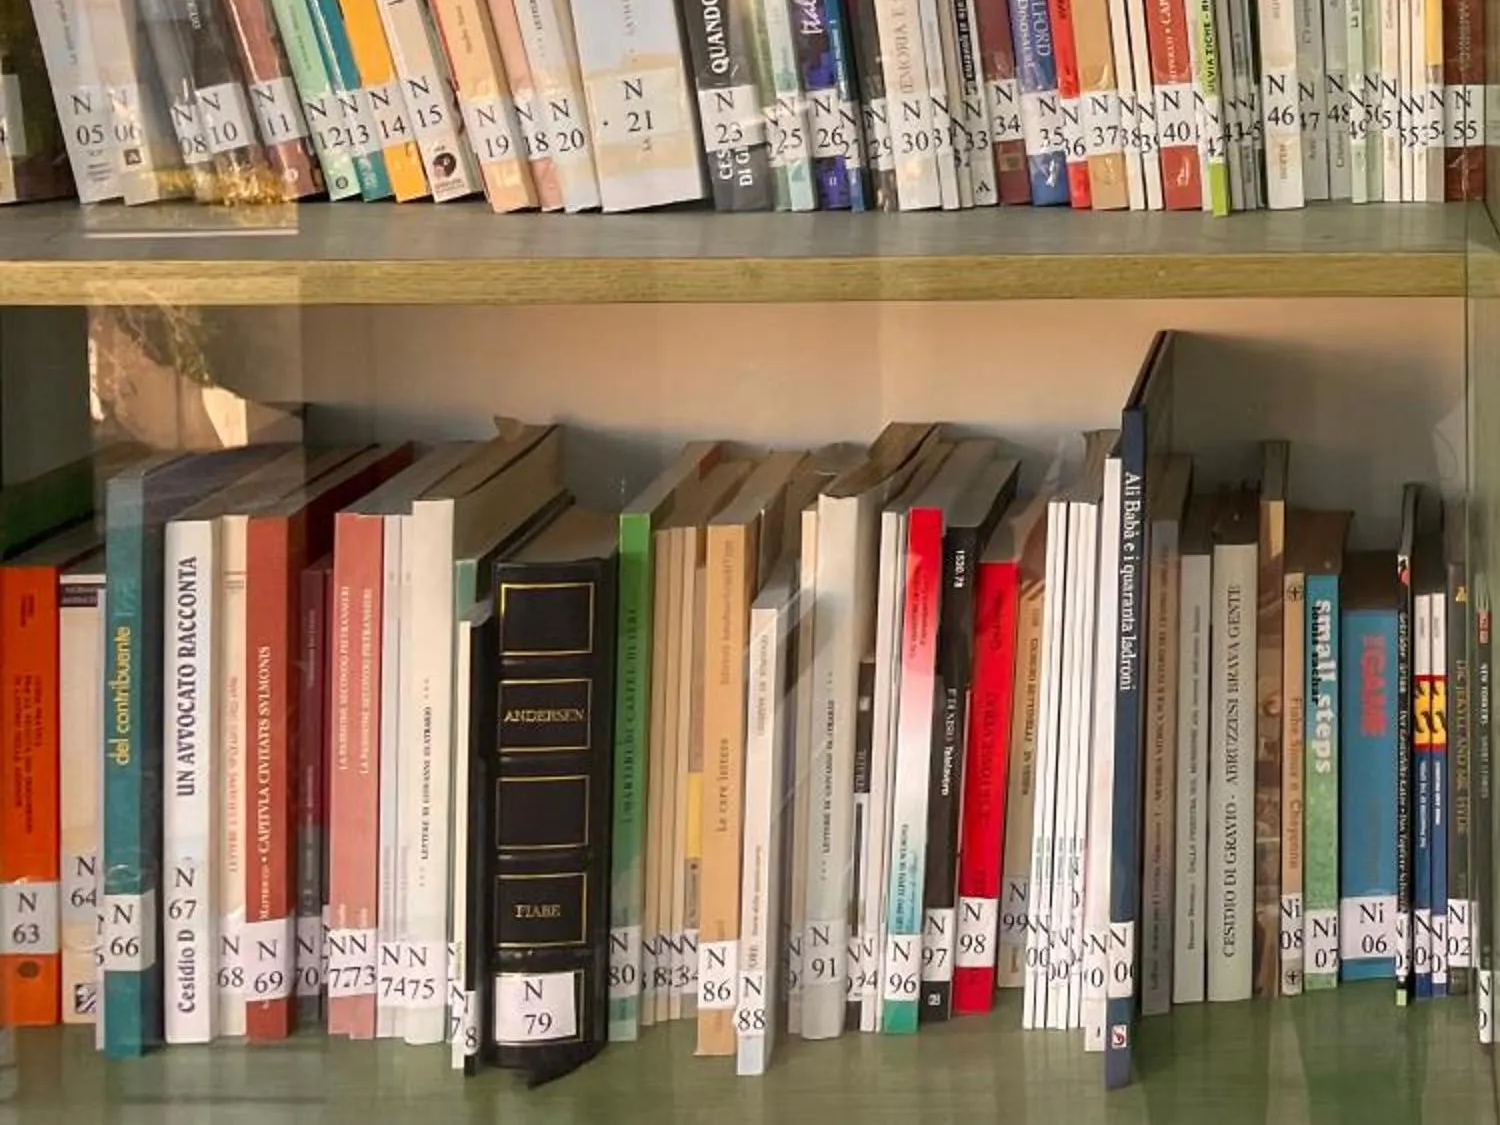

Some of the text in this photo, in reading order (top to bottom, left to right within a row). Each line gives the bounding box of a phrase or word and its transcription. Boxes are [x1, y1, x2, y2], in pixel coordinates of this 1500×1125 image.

[623, 78, 644, 100] N
[1267, 75, 1286, 95] N
[1161, 91, 1181, 111] N
[628, 110, 653, 132] 21
[1268, 106, 1294, 126] 46
[902, 133, 929, 153] 30
[1124, 472, 1141, 498] Ali
[1122, 500, 1140, 540] Babà
[1123, 542, 1135, 552] e
[1117, 564, 1134, 632] quaranta
[1118, 635, 1137, 691] ladroni
[177, 555, 198, 797] UN AVVOCATO RACCONTA
[1312, 599, 1337, 774] small steps
[112, 624, 132, 766] del contribuente
[503, 706, 585, 723] ANDERSEN
[255, 645, 272, 855] CAPITVLA CIVITATIS SVLMONIS
[1223, 583, 1242, 958] CESIDIO DI GRAVIO ABRUZZESI BRAVA GENTE
[175, 867, 194, 888] N
[19, 893, 37, 913] N
[168, 899, 197, 920] 67
[514, 903, 561, 918] FIABE
[963, 902, 983, 922] N
[1360, 903, 1384, 923] Ni
[114, 904, 133, 924] N
[13, 923, 40, 944] 63
[812, 926, 830, 946] N
[110, 937, 139, 957] 66
[221, 936, 240, 955] N
[259, 939, 278, 961] N
[892, 942, 911, 962] N
[959, 935, 986, 954] 98
[1362, 935, 1387, 954] 06
[217, 967, 244, 988] 68
[812, 958, 836, 978] 91
[178, 948, 196, 1013] Cesidio
[253, 972, 283, 993] 69
[525, 980, 543, 1001] N
[890, 974, 917, 994] 96
[704, 981, 731, 1002] 86
[525, 1013, 552, 1034] 79
[738, 1010, 766, 1031] 88
